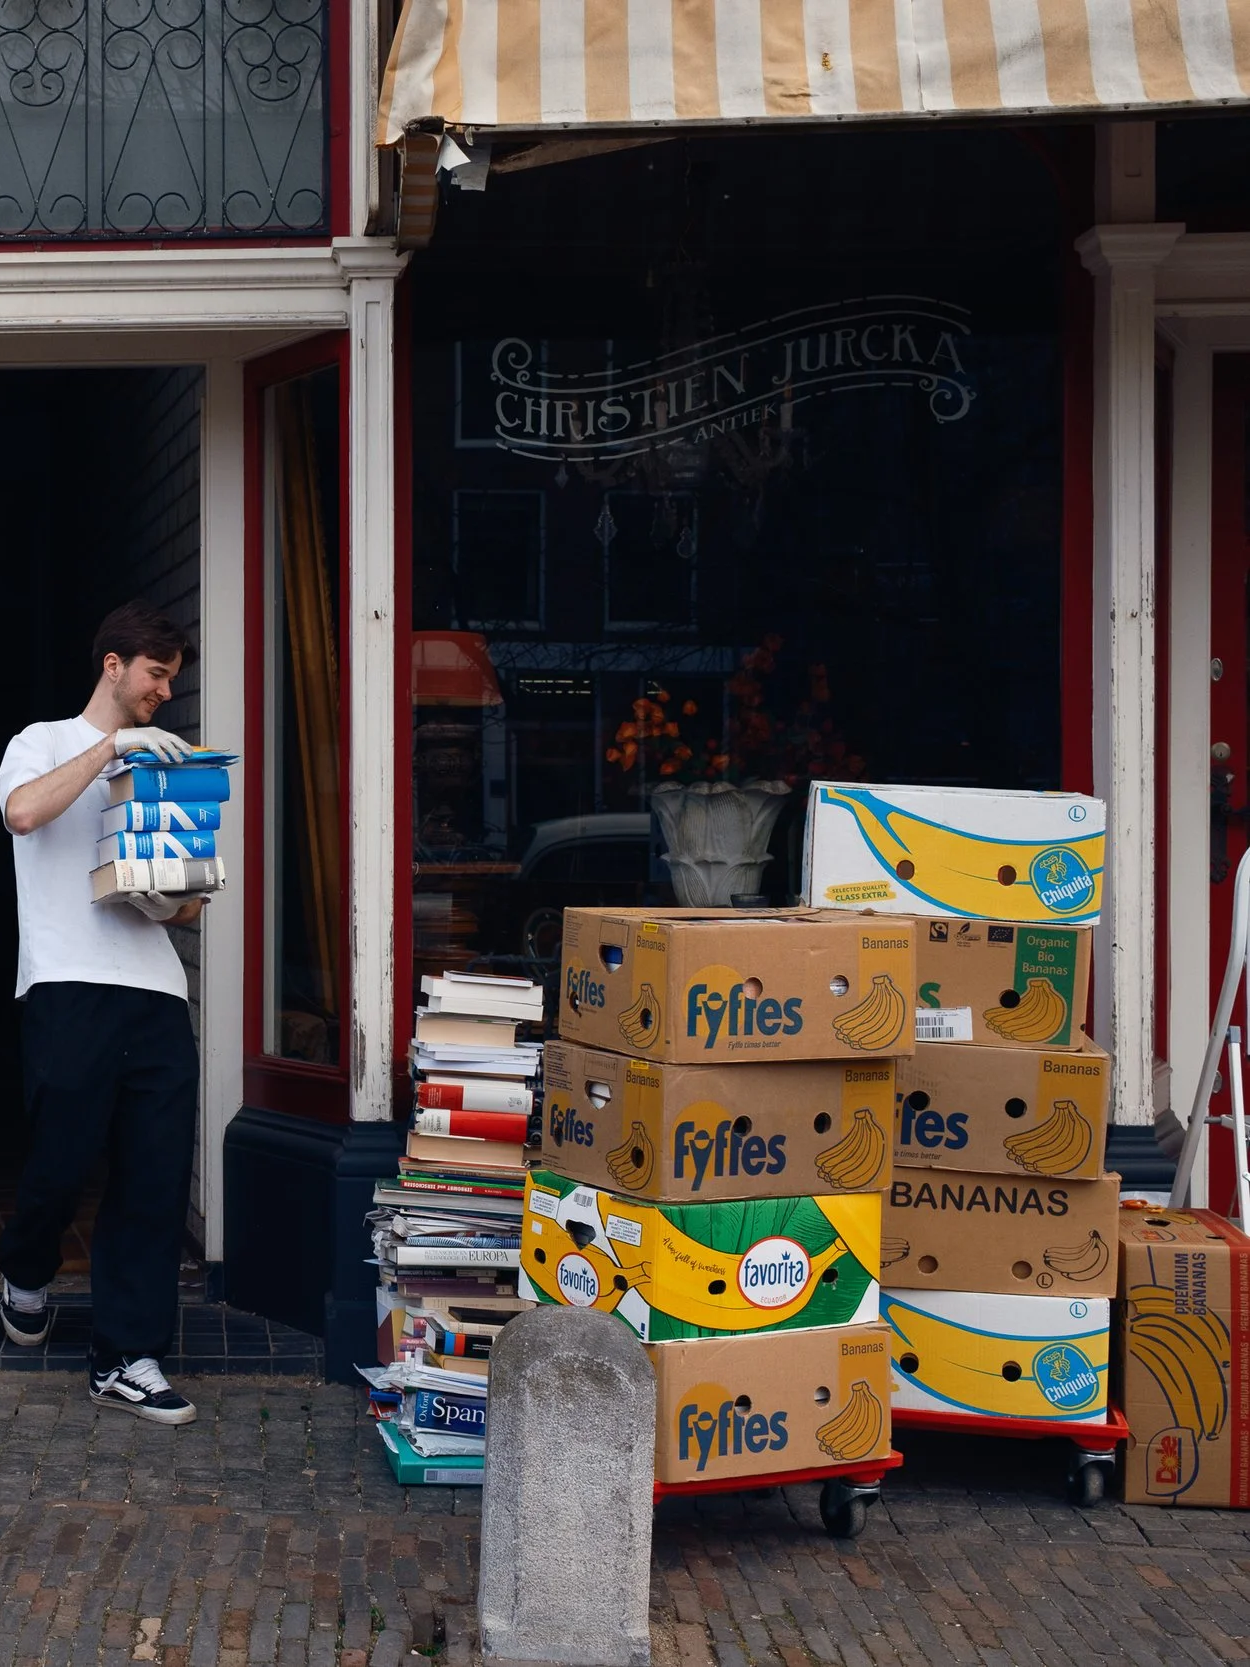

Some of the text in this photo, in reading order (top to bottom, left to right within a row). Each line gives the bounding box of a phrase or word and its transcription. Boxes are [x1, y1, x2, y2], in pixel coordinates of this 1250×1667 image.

[495, 324, 967, 441] CHRISTIEN JURCKA
[694, 401, 777, 444] ANTIEK
[832, 884, 888, 894] SELECTED QUALITY
[835, 891, 888, 902] CLASS EXTRA
[1040, 873, 1093, 906] Chiquita
[636, 935, 666, 953] Bananas
[862, 937, 909, 950] Bananas
[1026, 935, 1070, 949] Organic
[1038, 951, 1055, 962] Bio
[1022, 962, 1068, 976] Bananas
[626, 1070, 660, 1088] Bananas
[845, 1069, 890, 1083] Bananas
[1043, 1060, 1101, 1076] Bananas
[920, 1151, 943, 1160] better
[890, 1181, 1069, 1217] BANANAS
[469, 1250, 509, 1262] EUROPA
[662, 1237, 670, 1246] A
[669, 1241, 678, 1256] box
[675, 1250, 690, 1265] full
[690, 1256, 697, 1271] of
[559, 1262, 596, 1298] favorita
[744, 1258, 804, 1288] favorita
[1174, 1252, 1189, 1315] PREMIUM
[1192, 1251, 1207, 1317] BANANAS
[1239, 1252, 1249, 1292] BANANAS
[760, 1294, 787, 1304] ECUADOR
[1239, 1293, 1249, 1332] PREMIUM
[841, 1340, 884, 1356] Bananas
[1239, 1342, 1248, 1380] BANANAS
[1044, 1370, 1097, 1403] Chiquita
[1239, 1381, 1248, 1420] PREMIUM
[418, 1391, 430, 1422] Oxford
[431, 1396, 486, 1426] Span
[1155, 1435, 1178, 1484] Dole
[1238, 1430, 1248, 1468] BANANAS
